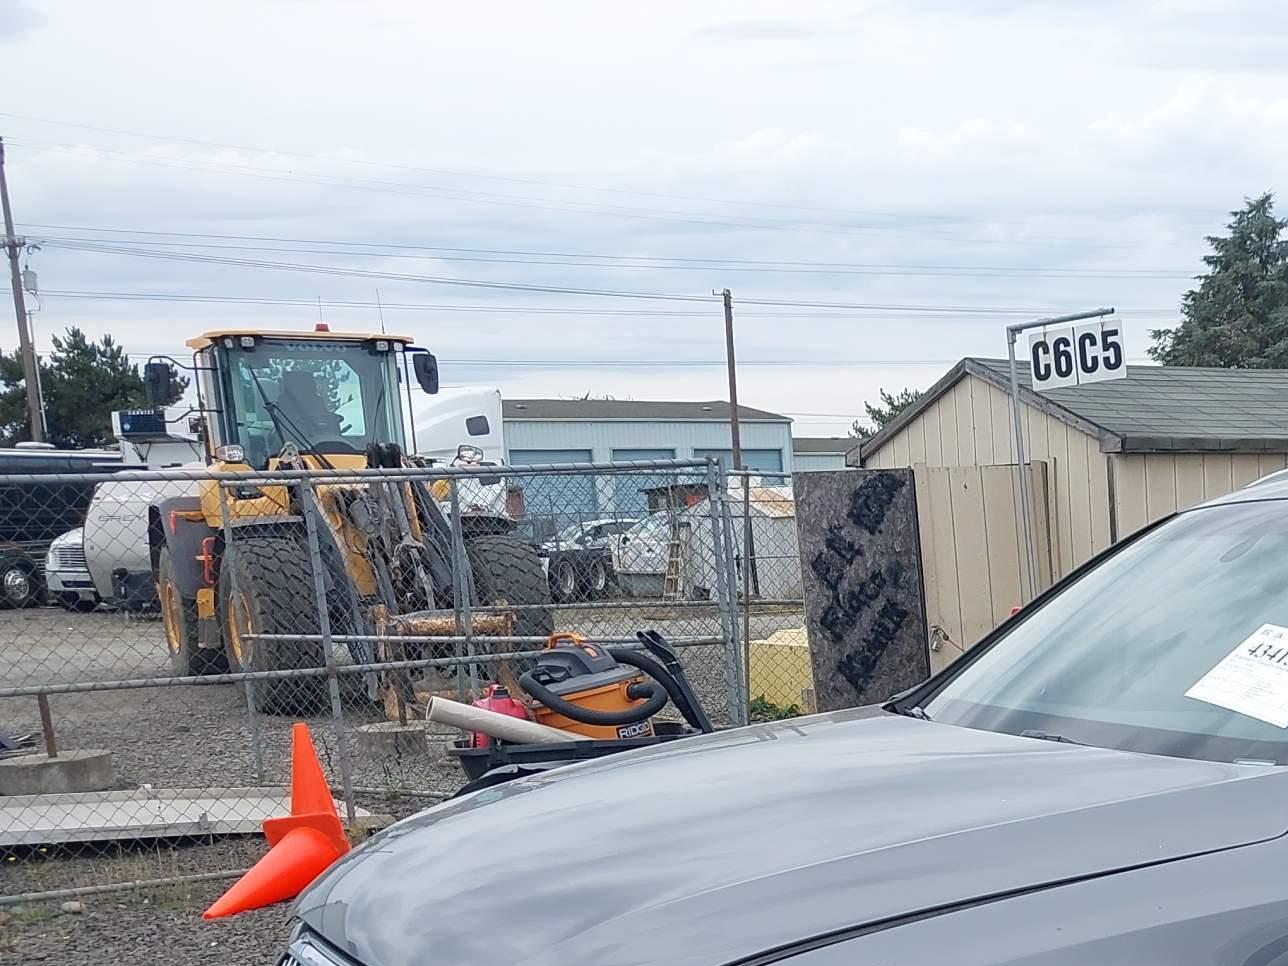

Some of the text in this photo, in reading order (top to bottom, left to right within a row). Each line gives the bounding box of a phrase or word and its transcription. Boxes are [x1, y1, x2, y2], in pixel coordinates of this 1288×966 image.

[1032, 328, 1122, 382] C6 C5
[618, 721, 650, 739] RIDGID
